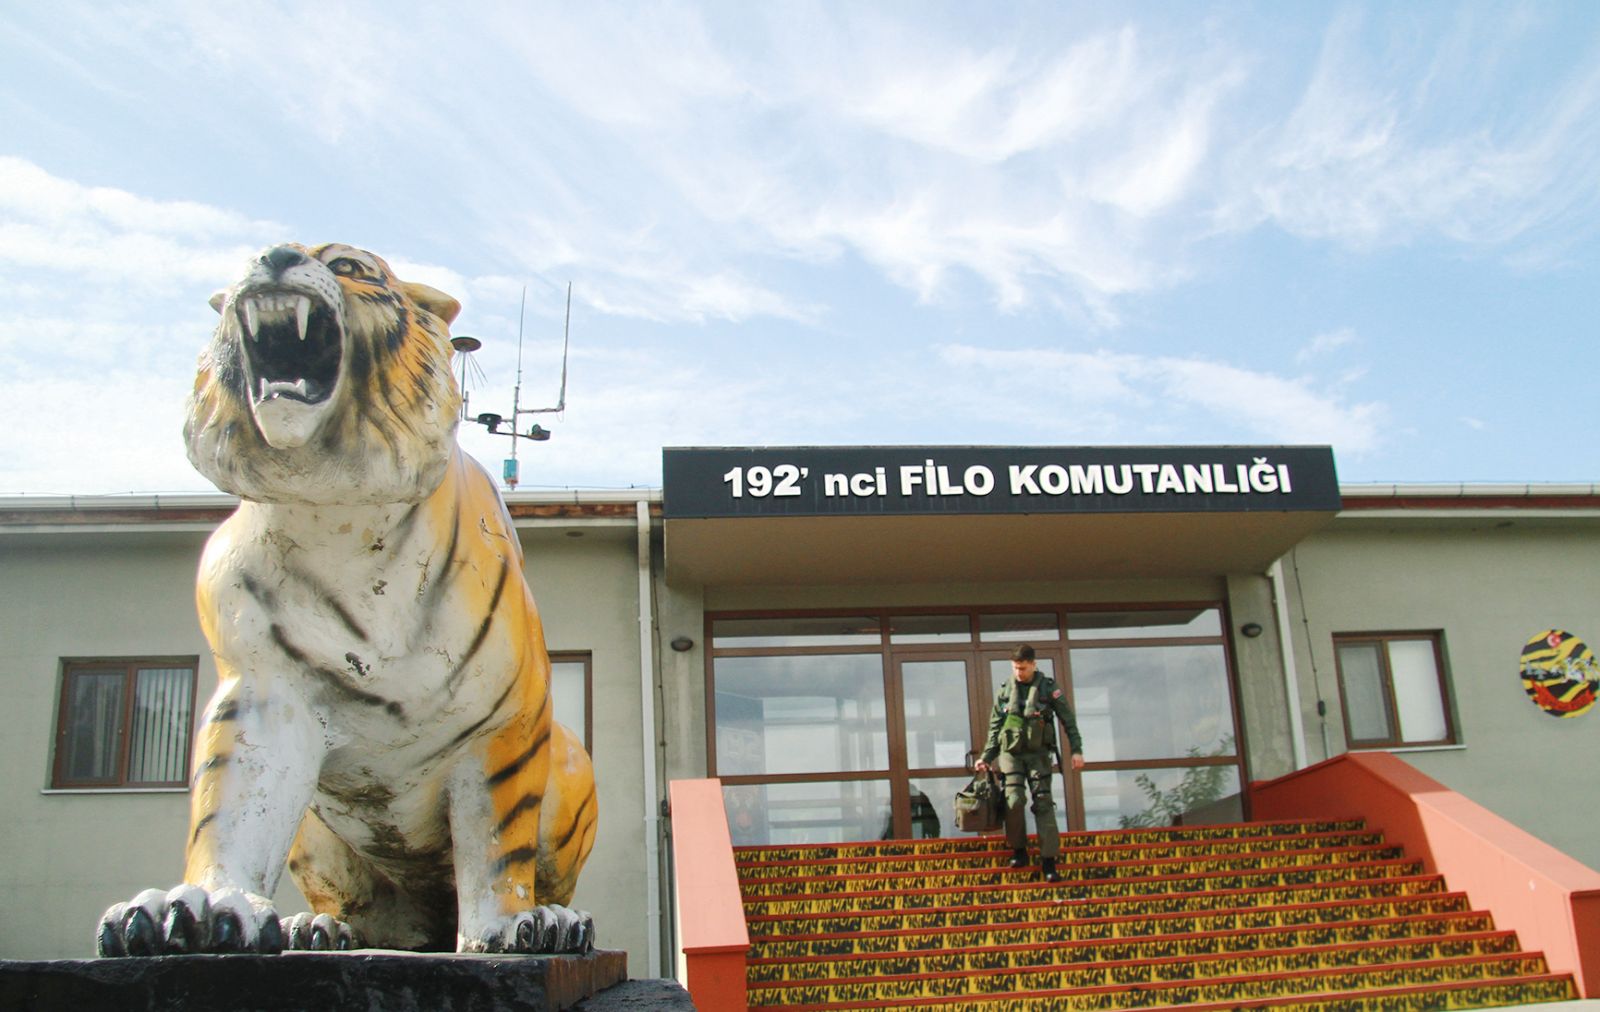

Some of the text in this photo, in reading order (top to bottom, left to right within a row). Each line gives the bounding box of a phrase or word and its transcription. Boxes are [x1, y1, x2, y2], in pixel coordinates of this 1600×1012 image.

[824, 467, 888, 497] nci
[899, 459, 995, 496] FİLO
[1008, 457, 1292, 495] KOMUTANLIĞI
